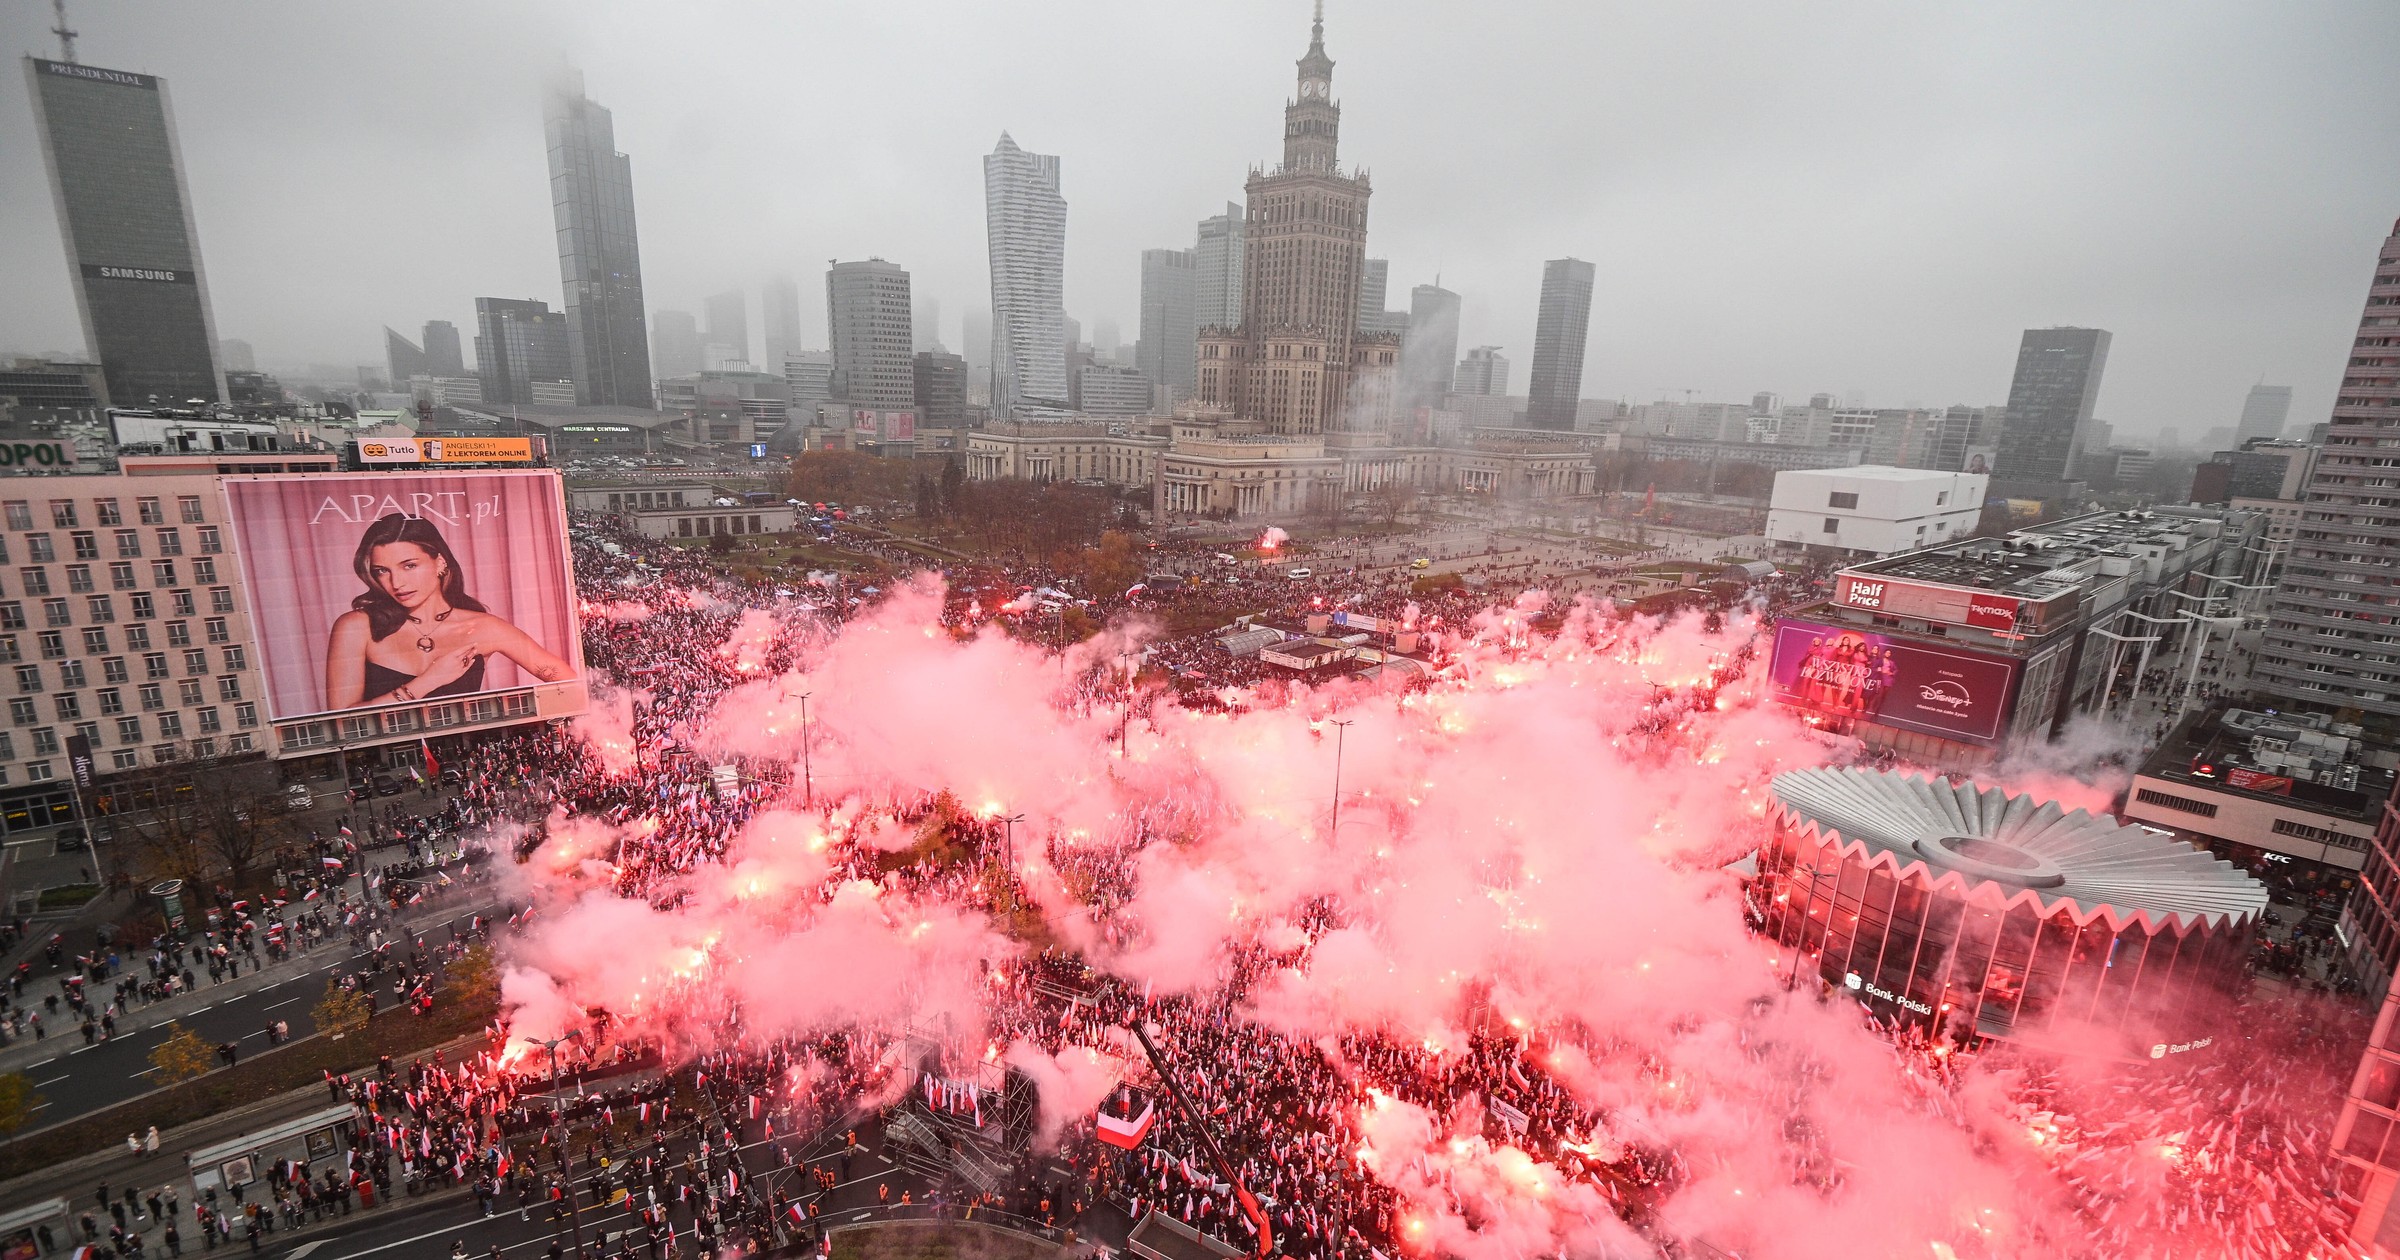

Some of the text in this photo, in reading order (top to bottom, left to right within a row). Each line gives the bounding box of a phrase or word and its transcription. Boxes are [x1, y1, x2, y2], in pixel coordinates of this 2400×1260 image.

[50, 63, 143, 85] PRESIDENTIAL
[101, 266, 175, 281] SAMSUNG
[389, 446, 415, 454] Tutlo
[1851, 581, 1883, 597] Half
[1849, 593, 1880, 607] Price
[1812, 656, 1872, 678] WSZYSTKO
[2263, 852, 2292, 864] KFC
[1865, 983, 1932, 1016] Bank Polski
[2169, 1042, 2191, 1053] Bank
